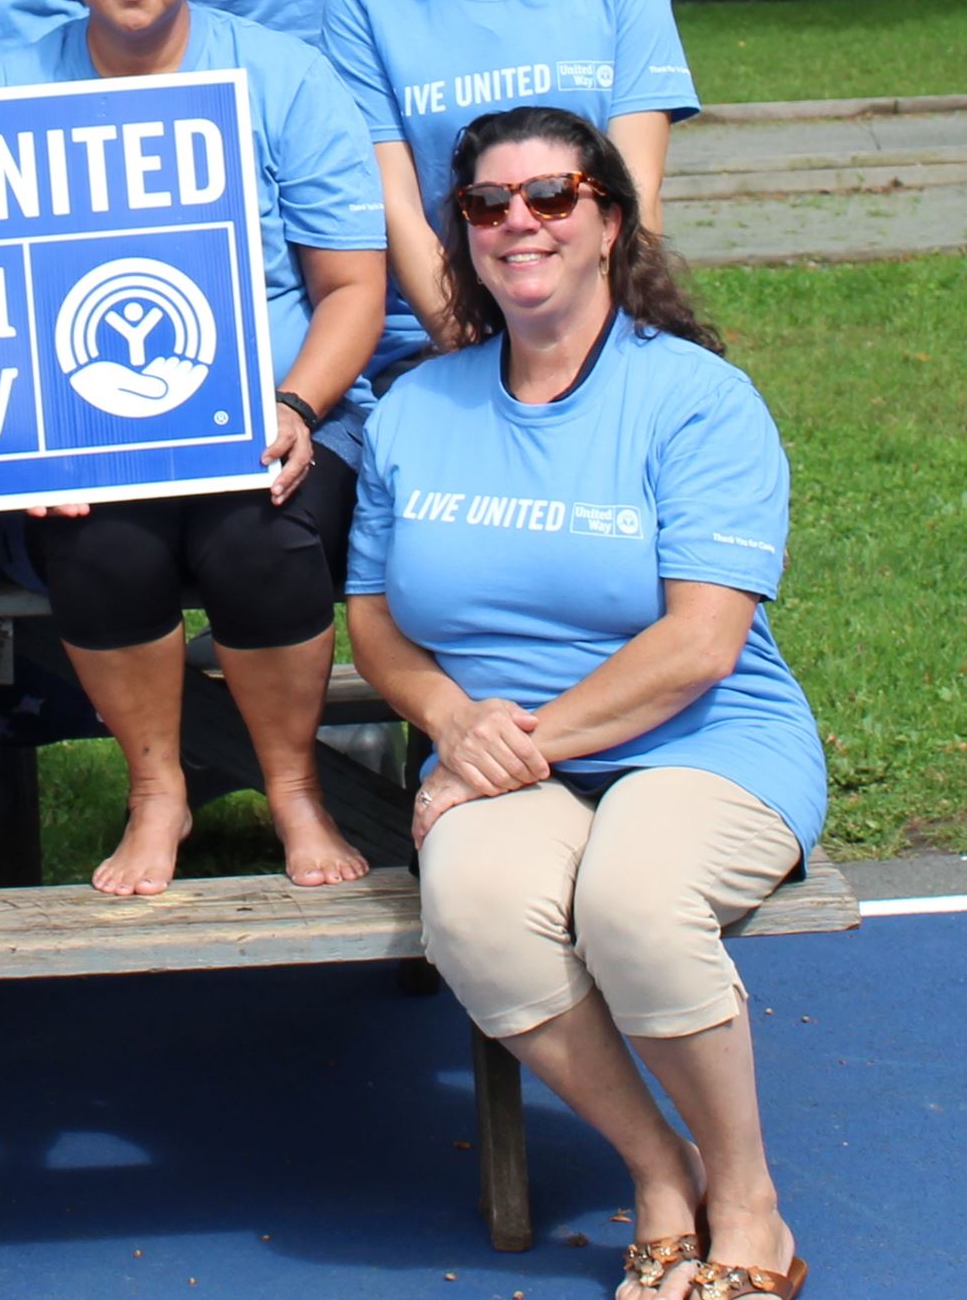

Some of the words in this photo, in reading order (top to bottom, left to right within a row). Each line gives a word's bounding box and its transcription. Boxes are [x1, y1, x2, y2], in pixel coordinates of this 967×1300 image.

[400, 80, 447, 117] IVE
[454, 64, 551, 107] UNITED
[403, 490, 465, 523] LIVE
[467, 496, 566, 532] UNITED
